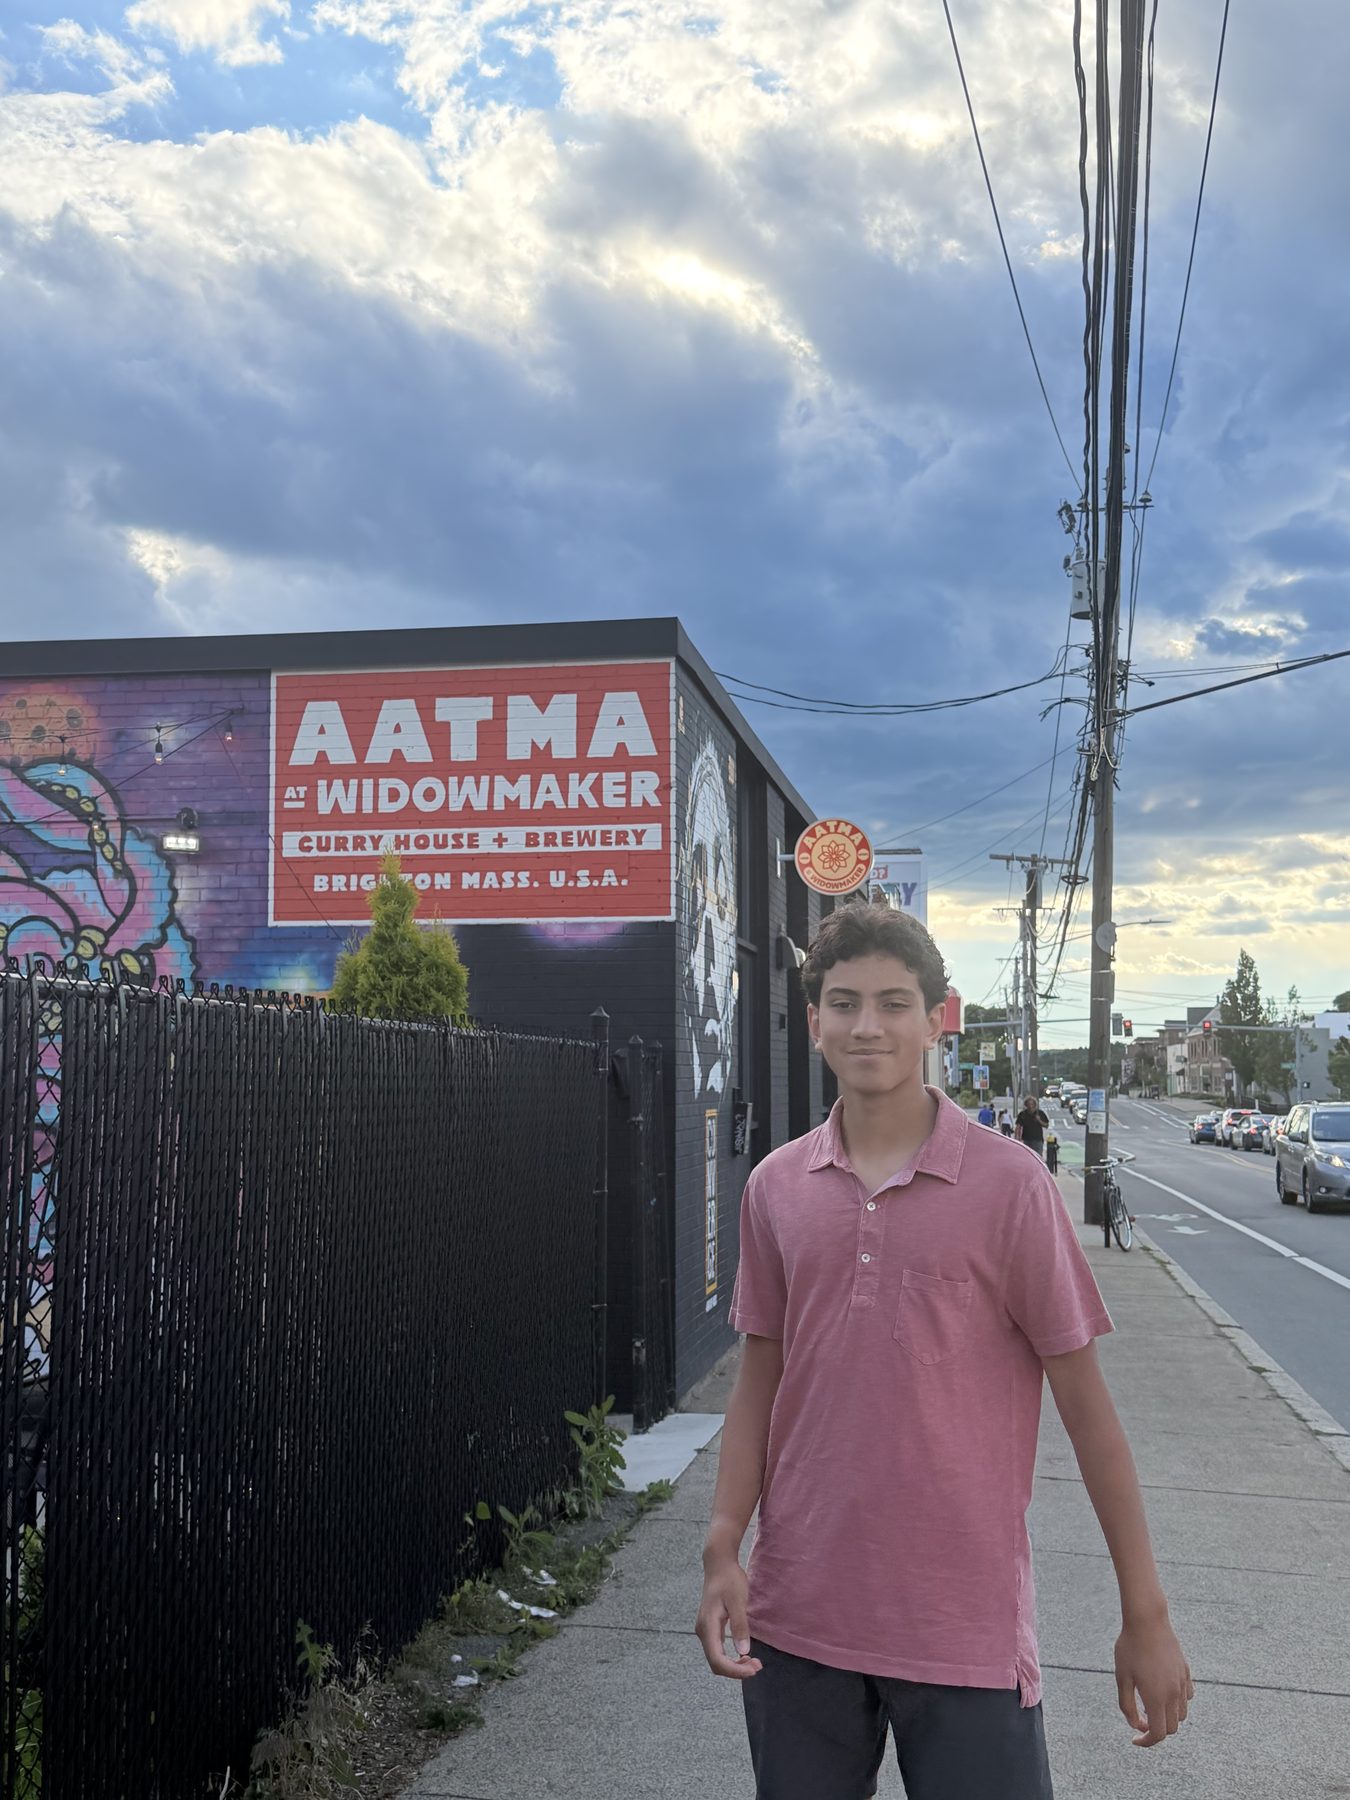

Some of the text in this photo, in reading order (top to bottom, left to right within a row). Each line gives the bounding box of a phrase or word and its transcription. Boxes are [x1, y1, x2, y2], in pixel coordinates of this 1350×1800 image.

[288, 691, 658, 766] AATMA
[284, 770, 662, 815] AT WIDOWMAKER
[298, 829, 647, 853] CURRY HOUSE + BREWERY
[803, 820, 864, 849] AATMA
[313, 869, 629, 892] BRIGON MASS. U.S.A.
[809, 866, 864, 889] WIDOWMAKER
